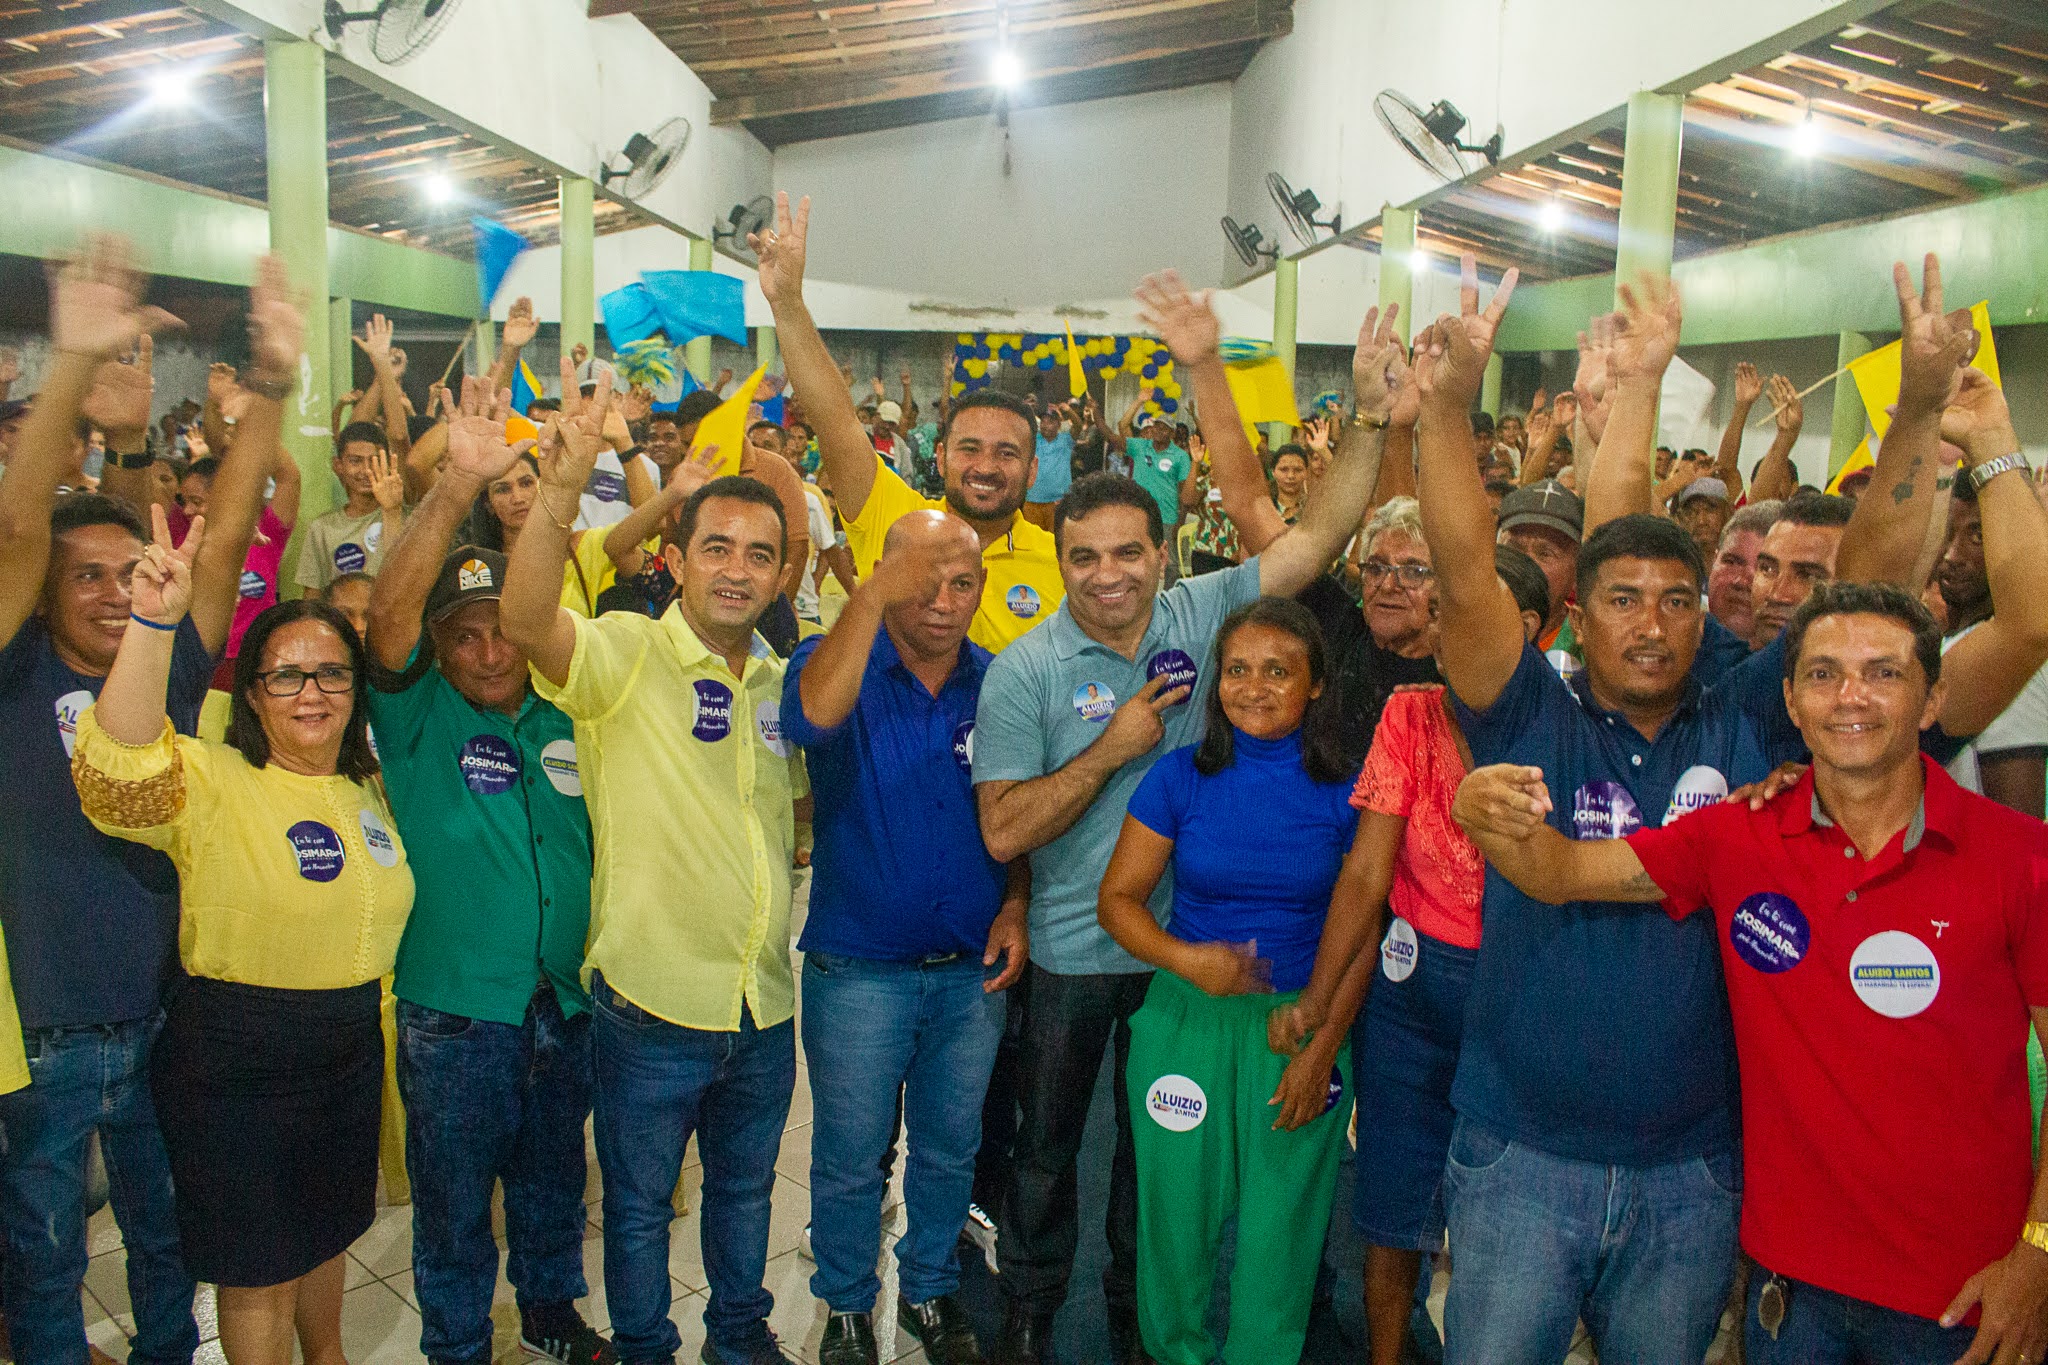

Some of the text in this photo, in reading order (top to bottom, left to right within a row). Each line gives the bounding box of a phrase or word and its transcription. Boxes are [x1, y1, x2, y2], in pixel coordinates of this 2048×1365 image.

[460, 573, 492, 590] NIKE
[1081, 701, 1112, 716] ALUIZIO
[460, 755, 511, 773] JOSIMAR
[1573, 809, 1629, 827] JOSIMAR
[1734, 909, 1794, 955] JOSIMAR
[1384, 938, 1414, 957] ALUIZIO
[1858, 968, 1930, 978] ALUIZIO SANTOS
[1152, 1090, 1202, 1112] ALUIZIO
[1174, 1108, 1199, 1119] SANTOS
